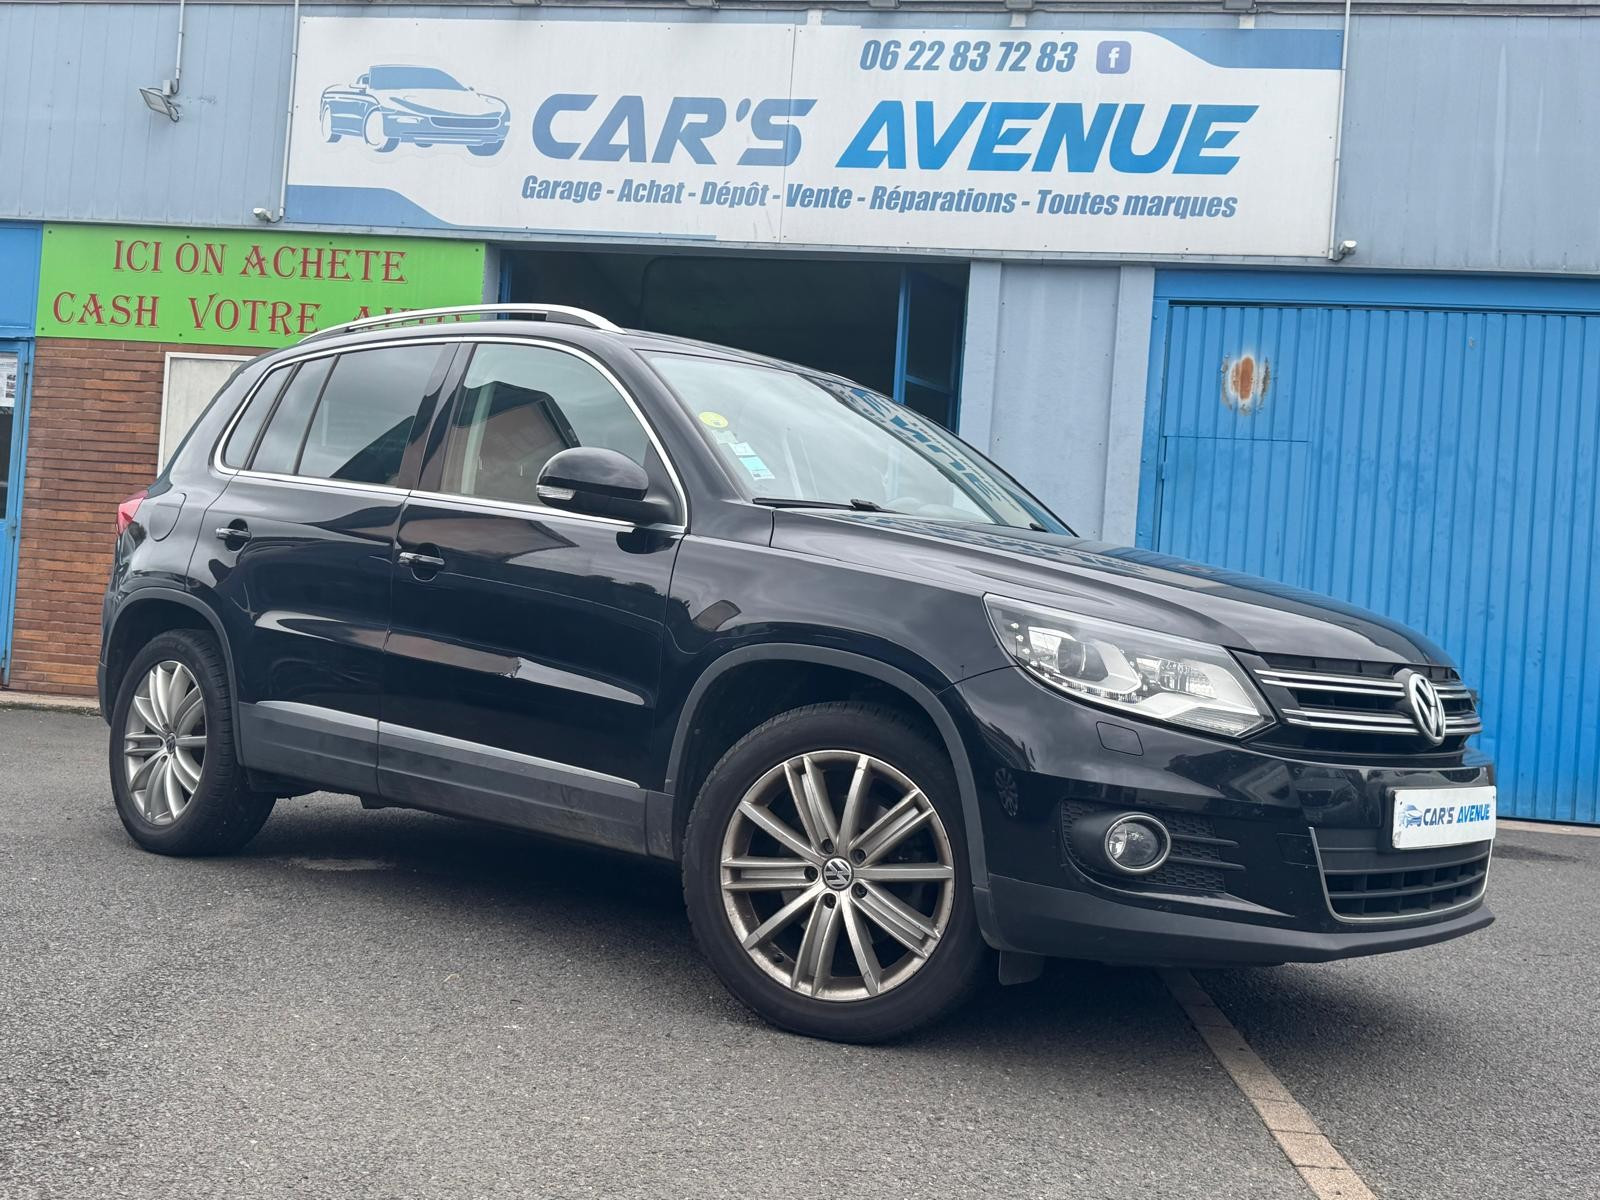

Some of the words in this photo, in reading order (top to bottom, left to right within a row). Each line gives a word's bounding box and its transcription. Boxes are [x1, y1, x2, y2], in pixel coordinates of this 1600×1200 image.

[859, 40, 901, 71] 06
[903, 40, 946, 71] 22
[948, 40, 991, 73] 83
[995, 41, 1032, 72] 72
[1035, 41, 1079, 73] 83
[532, 94, 816, 165] CAR'S
[834, 99, 1259, 175] AVENUE
[522, 176, 602, 203] Garage
[617, 178, 685, 204] Achat
[701, 181, 768, 208] Dépôt
[785, 183, 852, 209] Vente
[870, 185, 1016, 213] Réparations
[1036, 189, 1119, 216] Toutes
[1123, 194, 1238, 219] marques
[113, 240, 162, 273] ICI
[175, 242, 228, 275] ON
[239, 245, 407, 284] ACHETE
[53, 291, 160, 328] CASH
[188, 293, 322, 337] VOTRE
[1423, 807, 1455, 825] CAR'S
[1457, 804, 1490, 823] AVENUE
